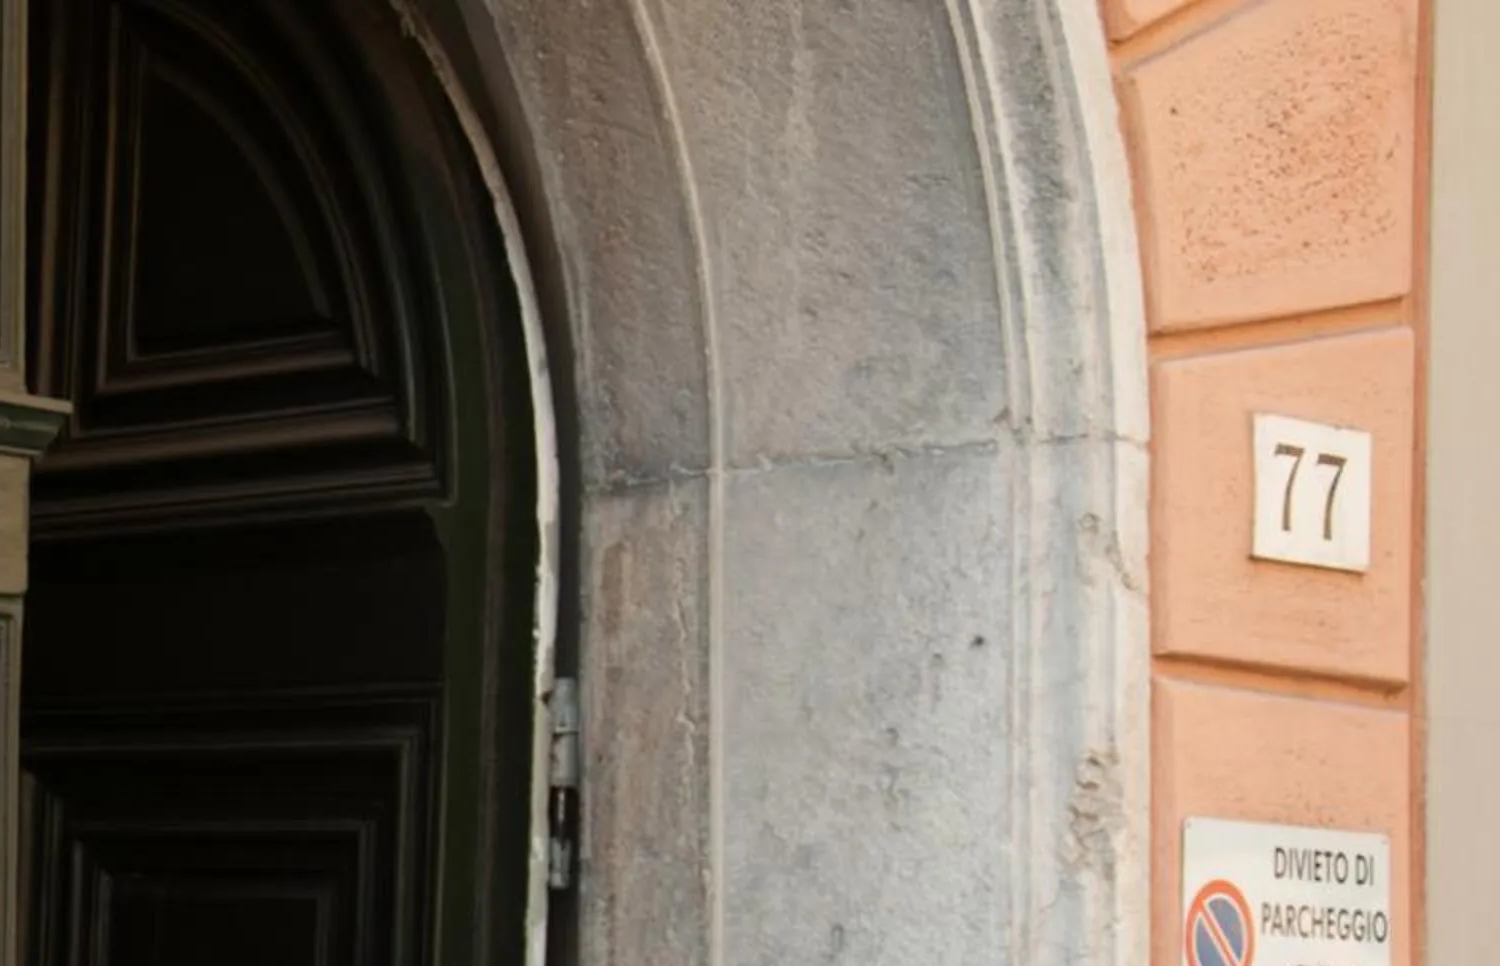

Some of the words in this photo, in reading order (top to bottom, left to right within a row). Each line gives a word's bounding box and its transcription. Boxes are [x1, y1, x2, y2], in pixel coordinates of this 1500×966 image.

[1274, 443, 1348, 541] 77
[1274, 847, 1349, 884] DIVIETO
[1355, 854, 1375, 886] DI
[1261, 902, 1388, 944] PARCHEGGIO
